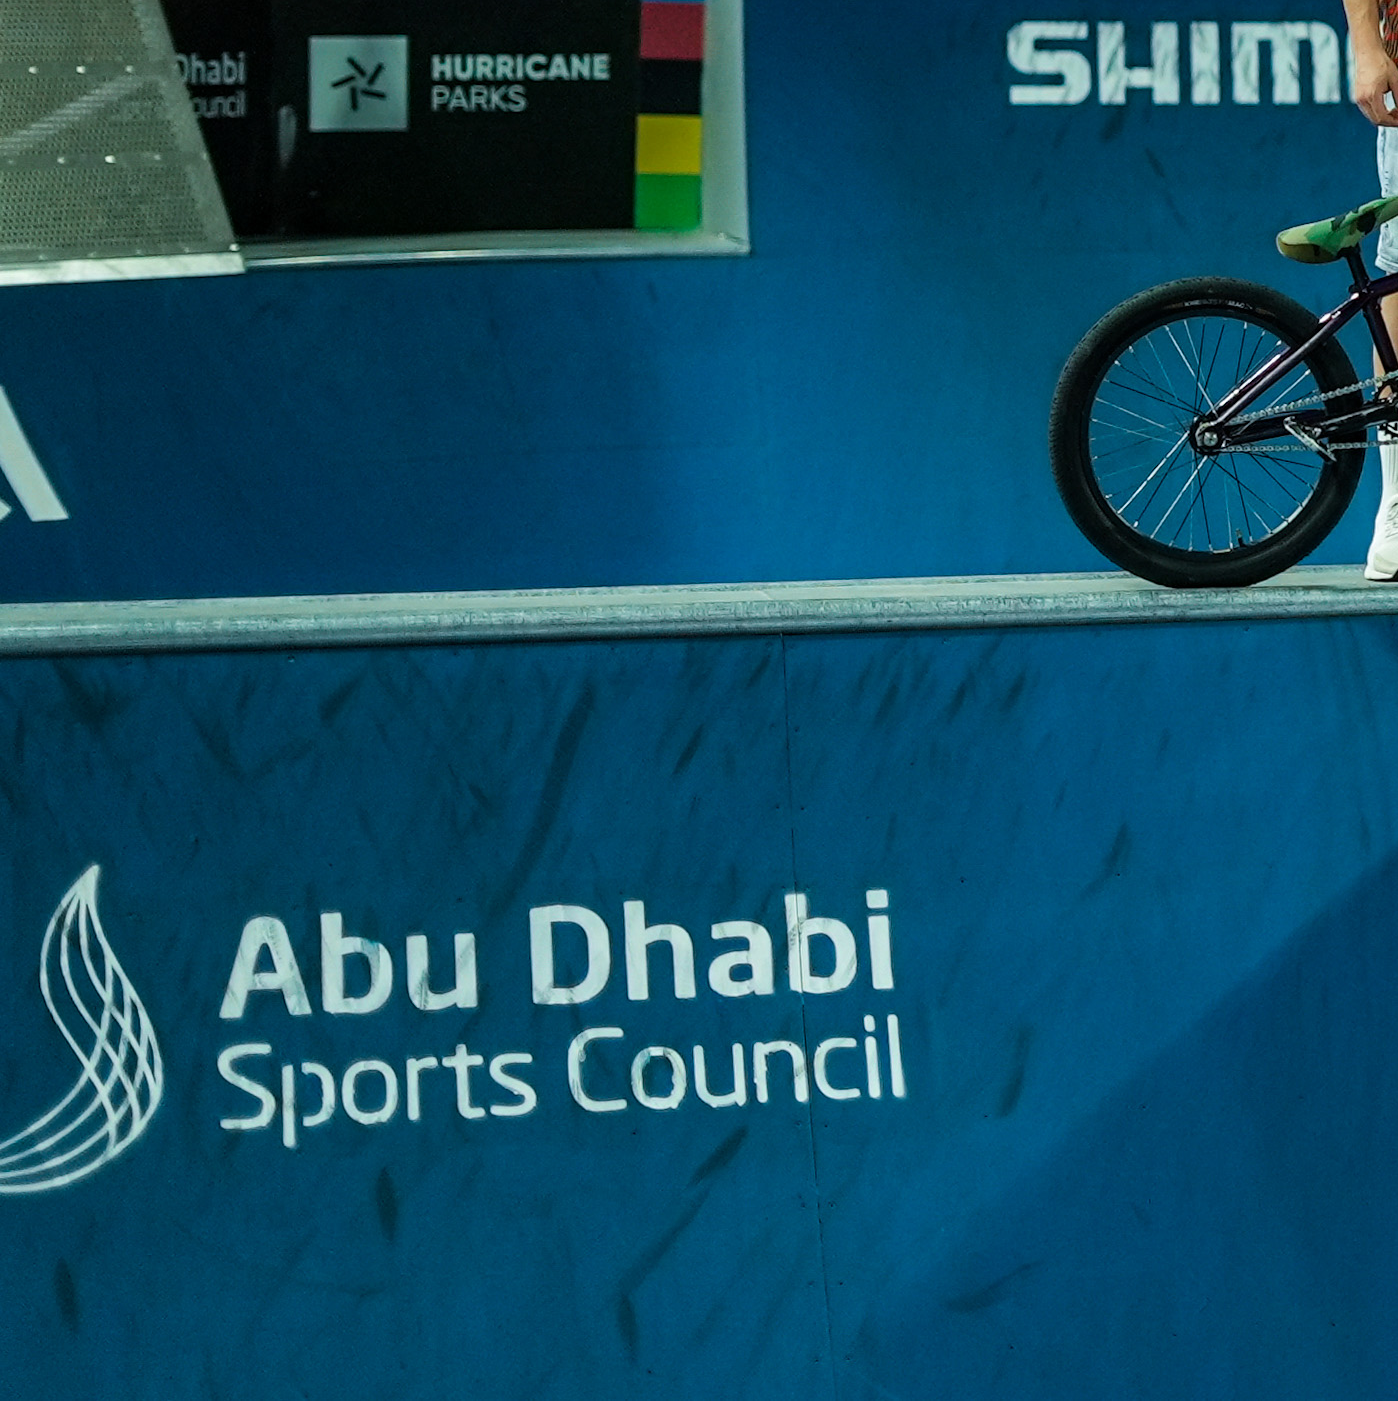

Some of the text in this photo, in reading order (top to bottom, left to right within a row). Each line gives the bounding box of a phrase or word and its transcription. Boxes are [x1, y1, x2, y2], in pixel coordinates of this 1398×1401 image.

[431, 53, 610, 81] HURRICANE
[1006, 20, 1362, 106] SHIM
[193, 90, 246, 119] ouncil
[431, 85, 527, 112] PARKS
[219, 890, 894, 1019] Abu Dhabi
[218, 1014, 906, 1148] Sports Council
